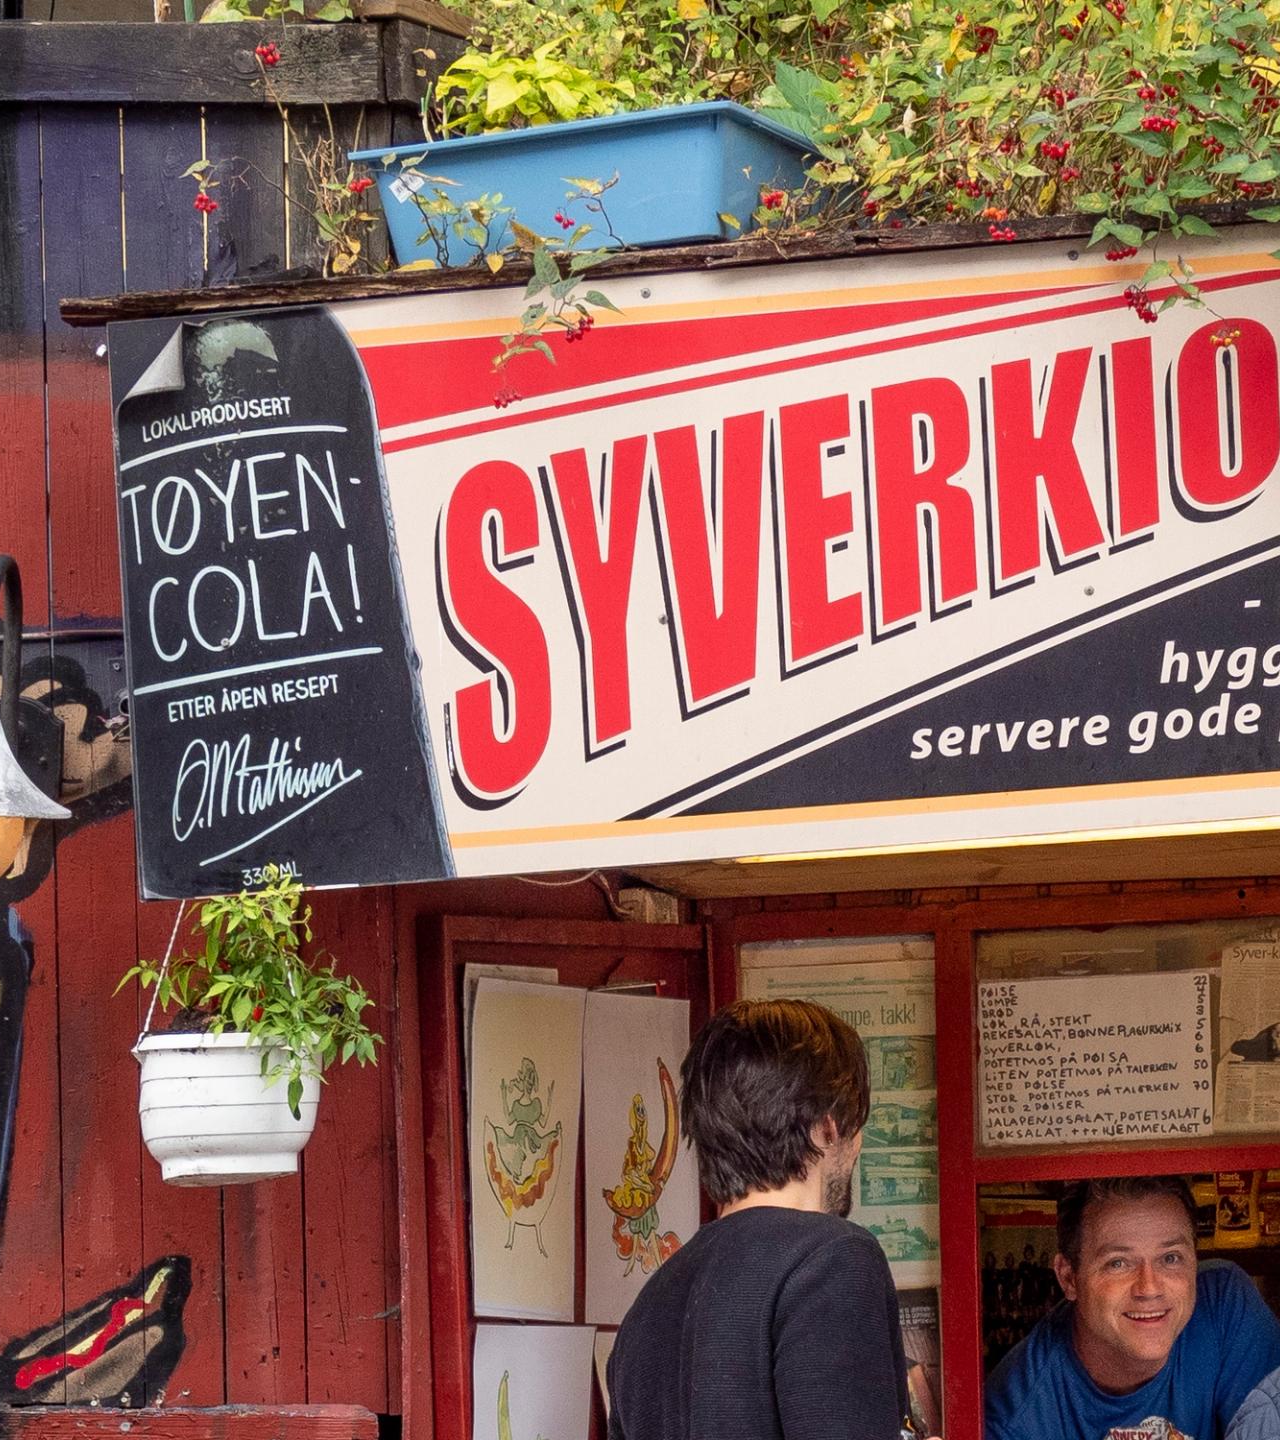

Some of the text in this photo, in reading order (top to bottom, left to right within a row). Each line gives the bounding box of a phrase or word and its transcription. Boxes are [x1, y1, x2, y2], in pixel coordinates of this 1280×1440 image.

[142, 396, 291, 443] LOKALPRODUSERT
[121, 451, 361, 565] TØYEN-
[149, 545, 364, 662] COLA!
[167, 674, 340, 723] ETTER ÅPEN RESEPT
[910, 714, 1109, 760] servere
[1128, 693, 1260, 754] gode
[279, 861, 303, 879] ML
[881, 1003, 916, 1025] takk!
[982, 1007, 1014, 1019] BRØD
[983, 1019, 1006, 1030] LØK
[1049, 1014, 1091, 1026] STEKT
[1193, 1060, 1208, 1070] 50
[986, 1081, 1013, 1091] MED
[987, 1093, 1018, 1104] STOR
[1193, 1080, 1209, 1091] 70
[988, 1104, 1015, 1114] MED
